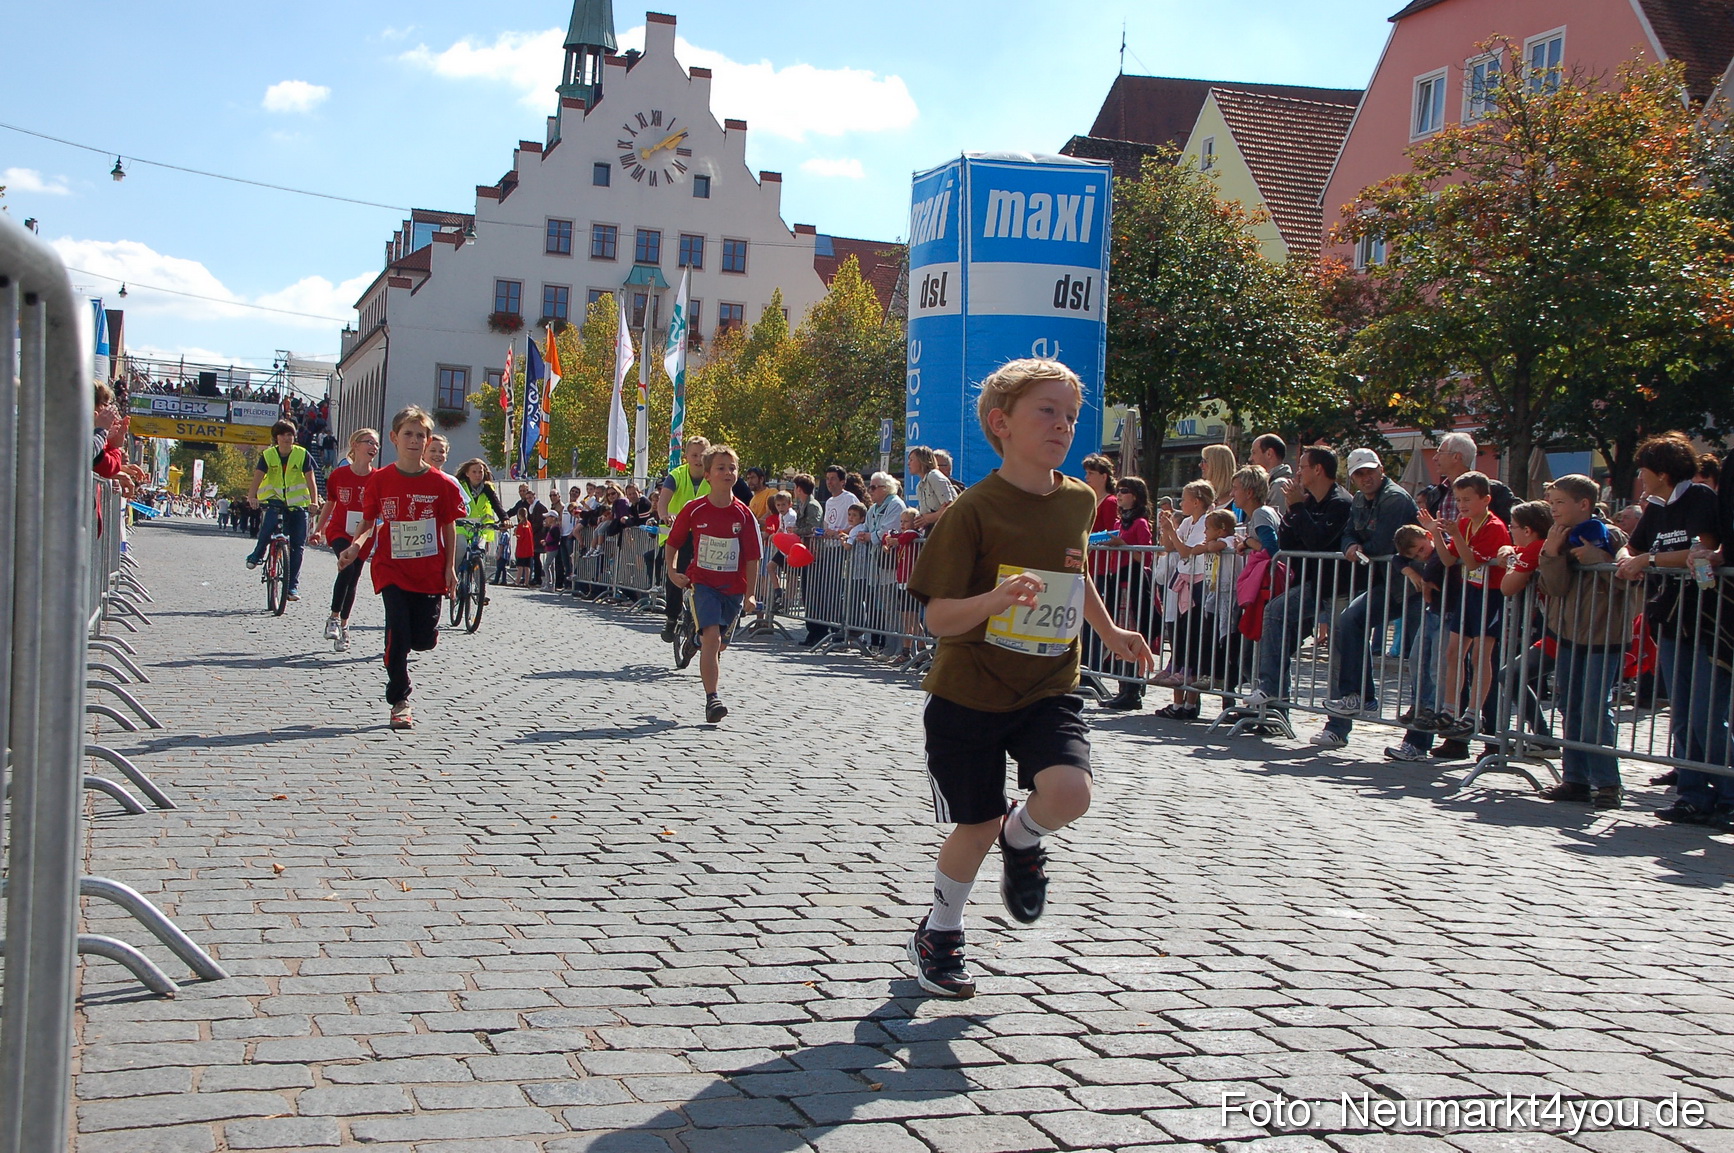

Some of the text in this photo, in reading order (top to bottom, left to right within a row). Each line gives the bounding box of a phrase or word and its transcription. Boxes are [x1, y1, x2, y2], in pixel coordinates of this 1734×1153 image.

[910, 179, 954, 247] maxi
[983, 185, 1096, 243] maxi
[919, 271, 948, 309] dsl
[1053, 274, 1091, 312] dsl
[152, 398, 208, 414] BOCK
[243, 408, 276, 417] PFLEIDERER
[176, 423, 226, 437] START
[882, 423, 890, 449] P
[404, 533, 433, 546] 7239
[710, 550, 736, 561] 7248
[1022, 604, 1077, 629] 7269
